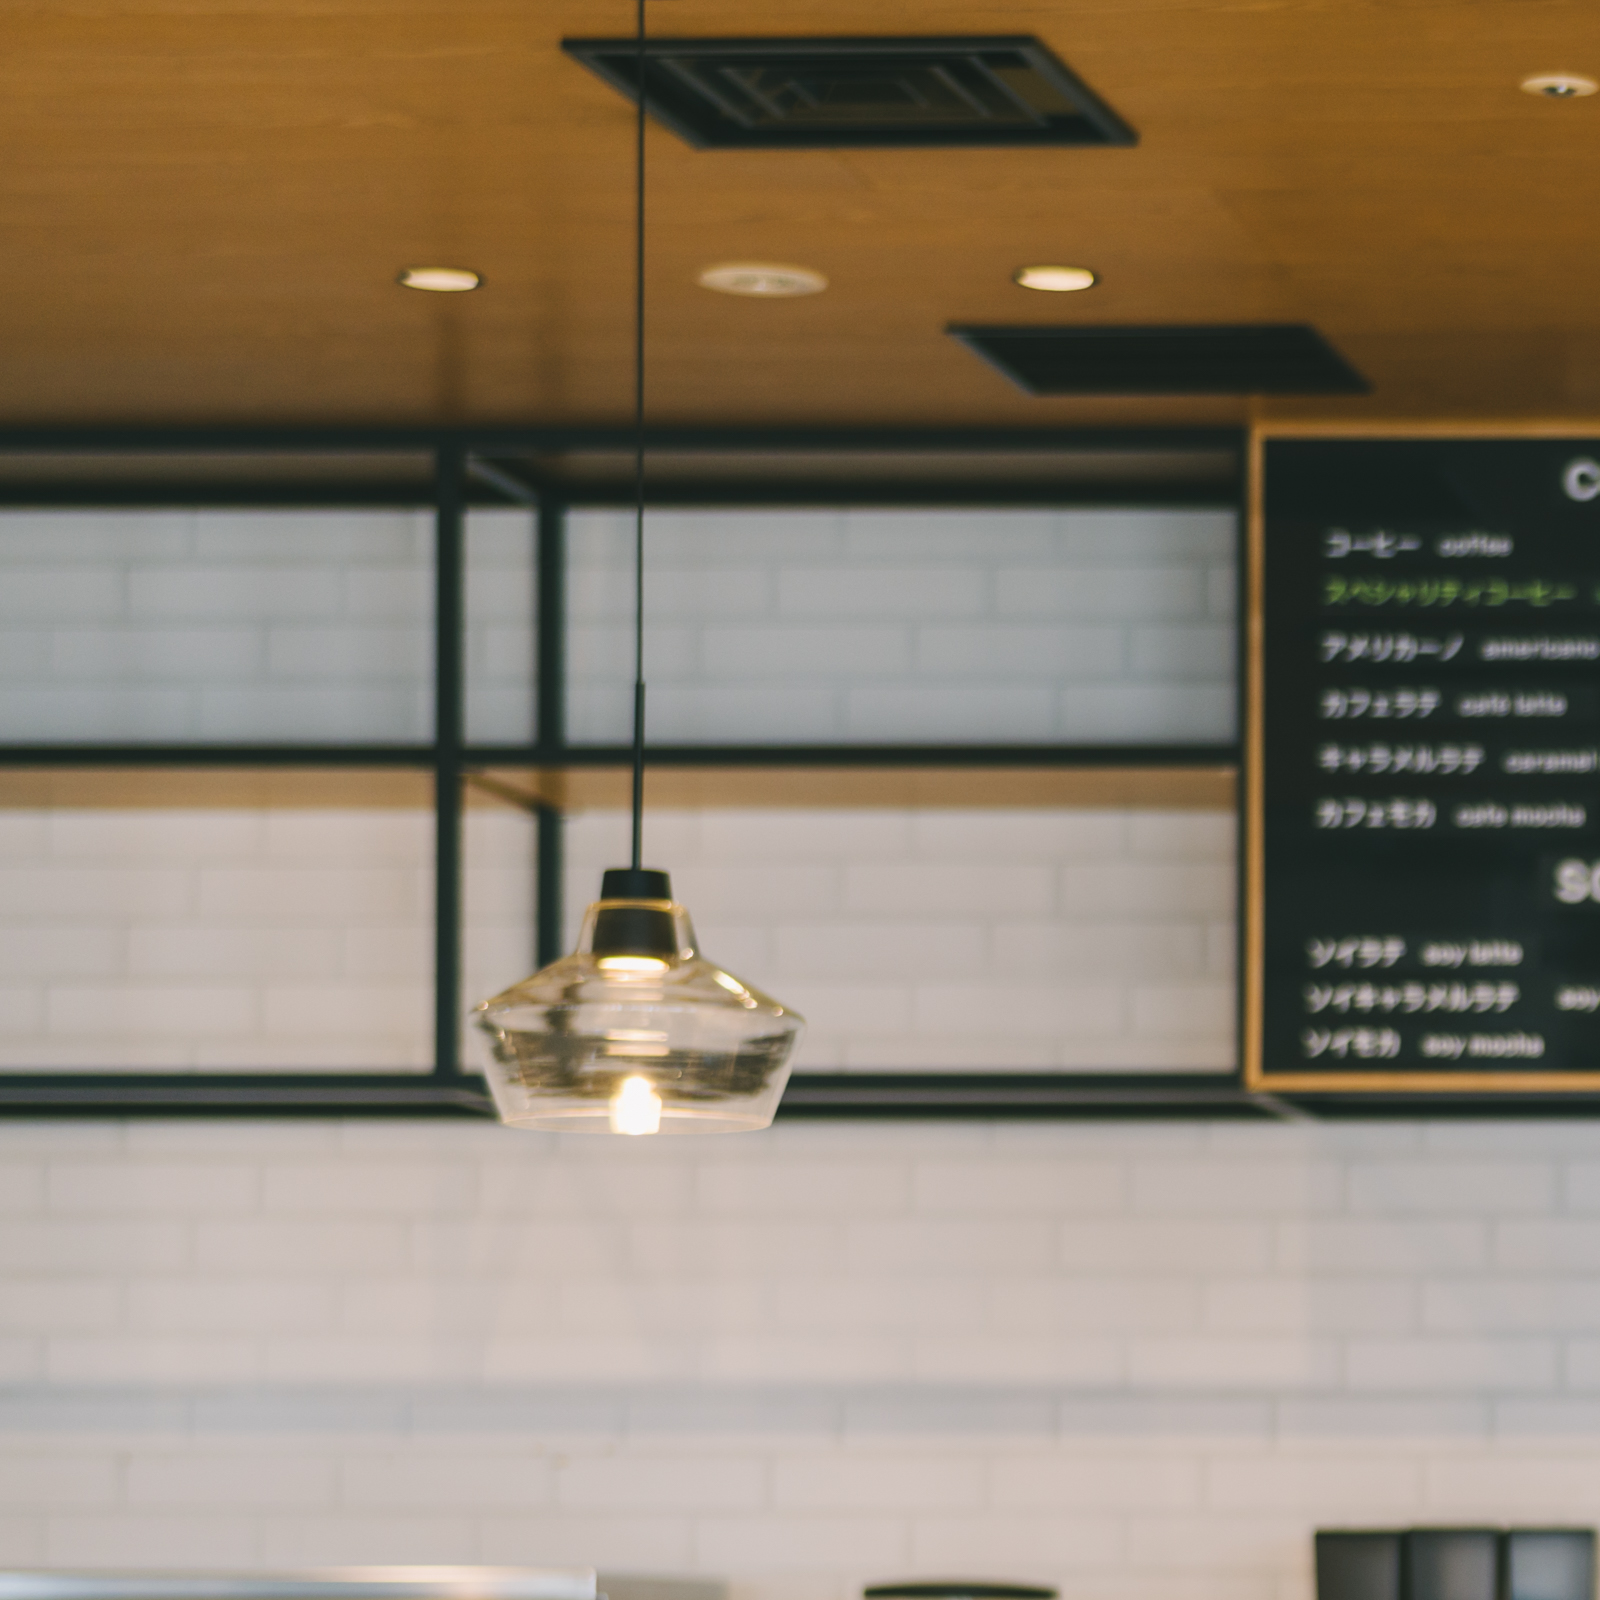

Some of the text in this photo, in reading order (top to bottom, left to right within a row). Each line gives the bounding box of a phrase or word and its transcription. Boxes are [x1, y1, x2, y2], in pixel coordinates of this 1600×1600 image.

[1328, 532, 1419, 558] コーヒー
[1323, 635, 1463, 661] アメリカーノ
[1323, 691, 1439, 717] カフェラテ
[1321, 746, 1483, 773] キャラメルラテ
[1318, 800, 1436, 827] カフェモカ
[1312, 938, 1405, 967] ソイラテ
